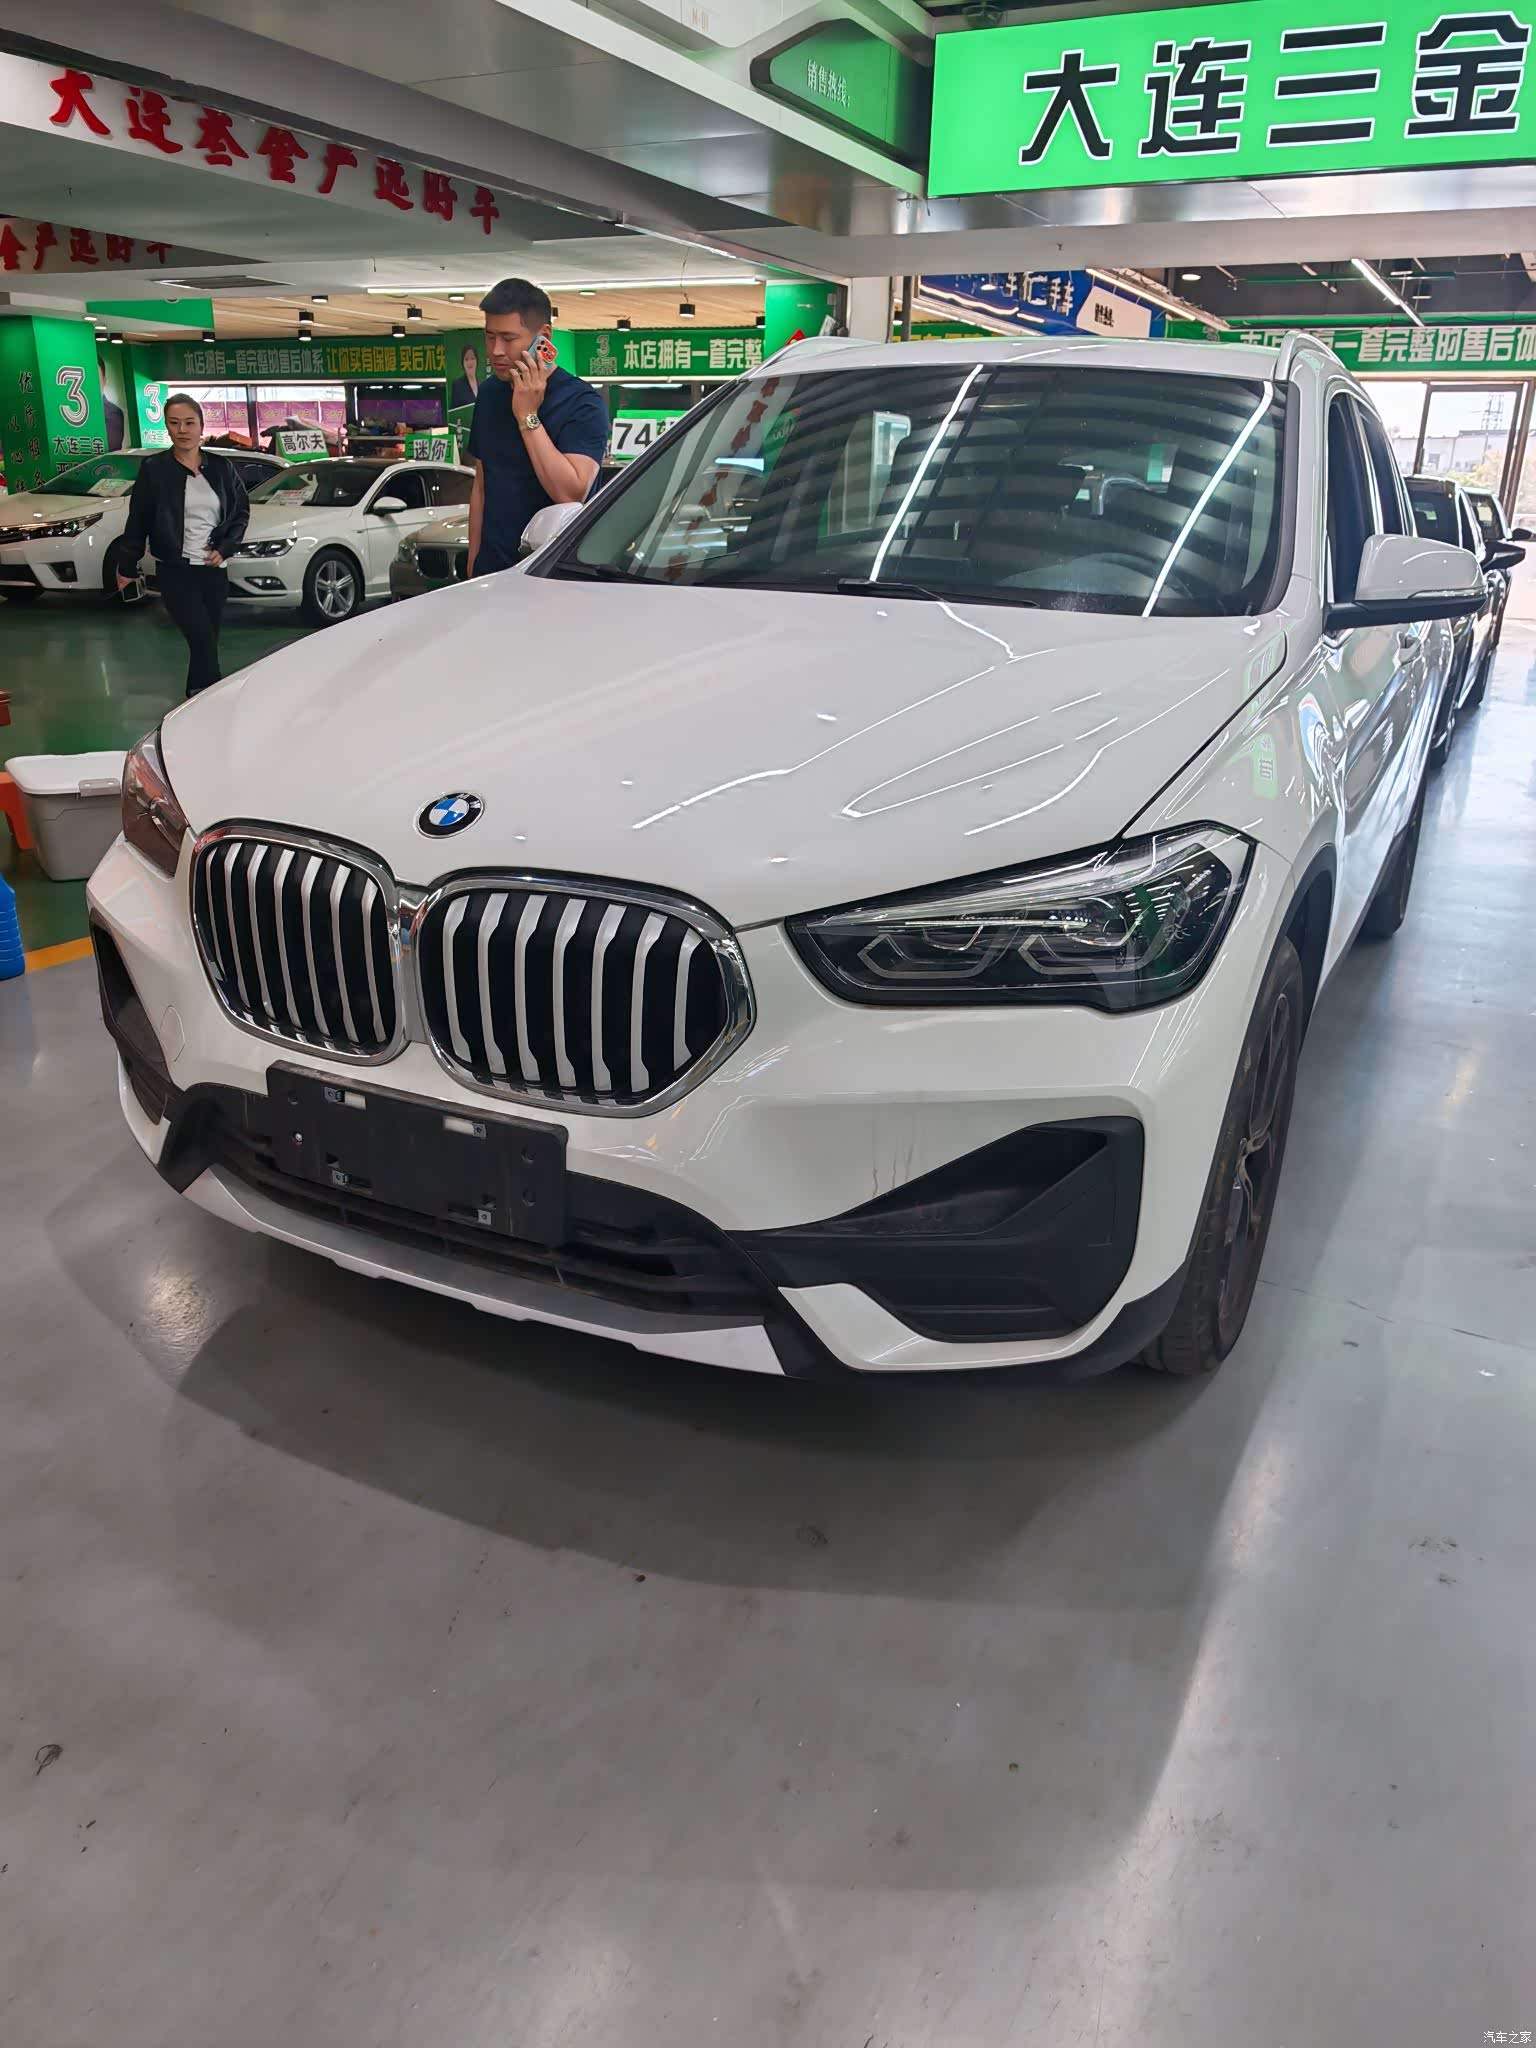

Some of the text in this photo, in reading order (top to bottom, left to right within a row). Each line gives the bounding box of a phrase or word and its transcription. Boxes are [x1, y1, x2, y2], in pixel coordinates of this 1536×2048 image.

[1019, 11, 1533, 166] 大连三金
[55, 365, 90, 428] 3
[53, 436, 105, 456] 大连三金
[281, 432, 325, 452] 高尔夫
[414, 439, 447, 460] 迷你
